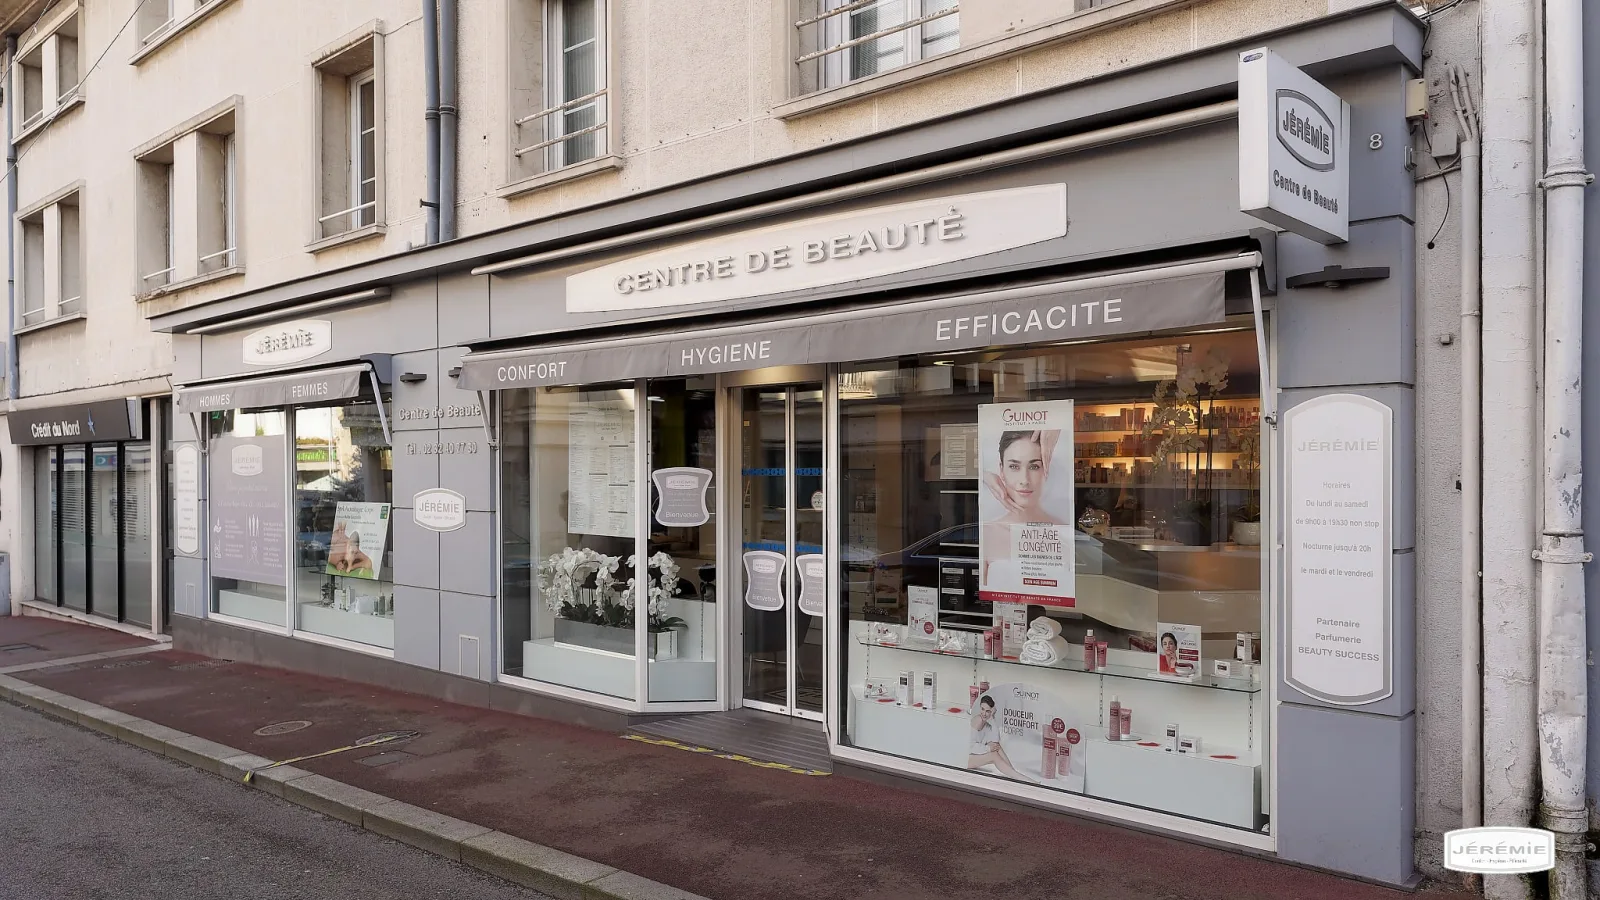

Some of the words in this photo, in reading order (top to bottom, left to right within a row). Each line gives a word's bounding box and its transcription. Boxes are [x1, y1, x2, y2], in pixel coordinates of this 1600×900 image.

[1282, 108, 1330, 155] JÉRÉMIE
[1369, 133, 1383, 150] 8
[1273, 169, 1301, 196] Centre
[1302, 185, 1311, 201] de
[1314, 189, 1339, 214] Beauté
[613, 254, 735, 296] CENTRE
[744, 245, 791, 274] DE
[801, 204, 965, 264] BEAUTÉ
[936, 298, 1123, 341] EFFICACITE
[681, 340, 772, 366] HYGIENE
[497, 361, 567, 382] CONFORT
[292, 382, 328, 398] FEMMES
[199, 393, 231, 408] HOMMES
[399, 407, 429, 420] Centre
[431, 405, 444, 418] de
[447, 404, 481, 417] Beauté
[1002, 408, 1048, 423] GUINOT
[31, 422, 51, 438] Crédit
[52, 423, 62, 437] du
[62, 420, 80, 436] Nord
[423, 443, 432, 455] 02
[1298, 438, 1378, 452] JÉRÉMIE
[1322, 481, 1351, 489] Horaires
[419, 500, 460, 514] JÉRÉMIE
[1344, 500, 1368, 508] samedi
[1364, 520, 1379, 528] stop
[1021, 528, 1059, 541] ANTI-ÂGE
[1018, 541, 1061, 553] LONGÉVITÉ
[1302, 542, 1332, 551] Nocturne
[1308, 567, 1327, 575] mardi
[1336, 568, 1343, 576] le
[1344, 569, 1374, 577] vendredi
[1316, 617, 1360, 628] Partenaire
[1315, 632, 1361, 644] Parfumerie
[1298, 646, 1333, 657] BEAUTY
[1335, 650, 1380, 662] SUCCESS
[1013, 687, 1039, 699] GUINOT
[1003, 708, 1034, 720] DOUCEUR
[1009, 719, 1039, 730] CONFORT
[1003, 727, 1024, 737] CORPS
